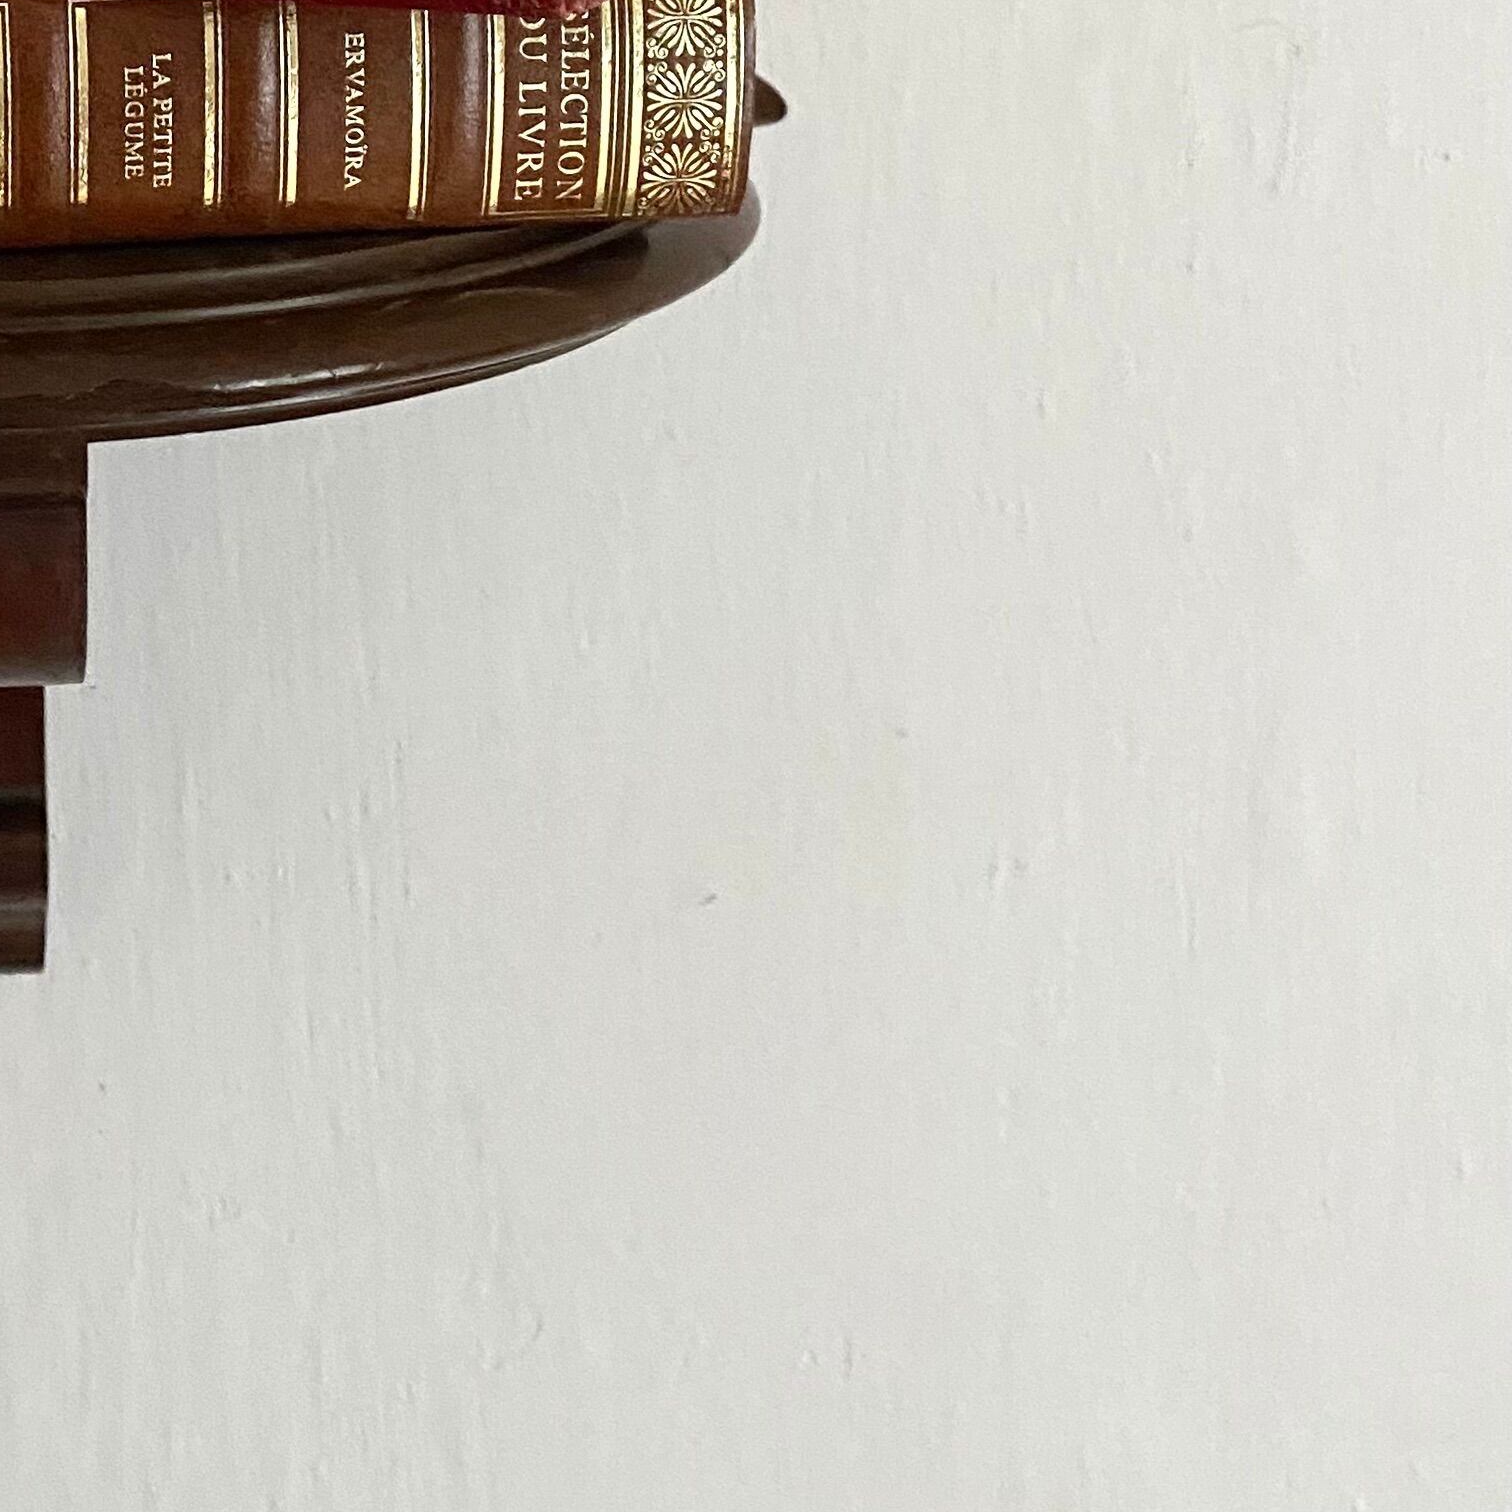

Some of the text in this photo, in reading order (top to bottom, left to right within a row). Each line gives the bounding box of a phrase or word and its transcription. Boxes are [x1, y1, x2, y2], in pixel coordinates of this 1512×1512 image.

[124, 66, 148, 180] LÉGUME
[152, 53, 173, 188] LA PETITE
[513, 81, 548, 201] LIVRE
